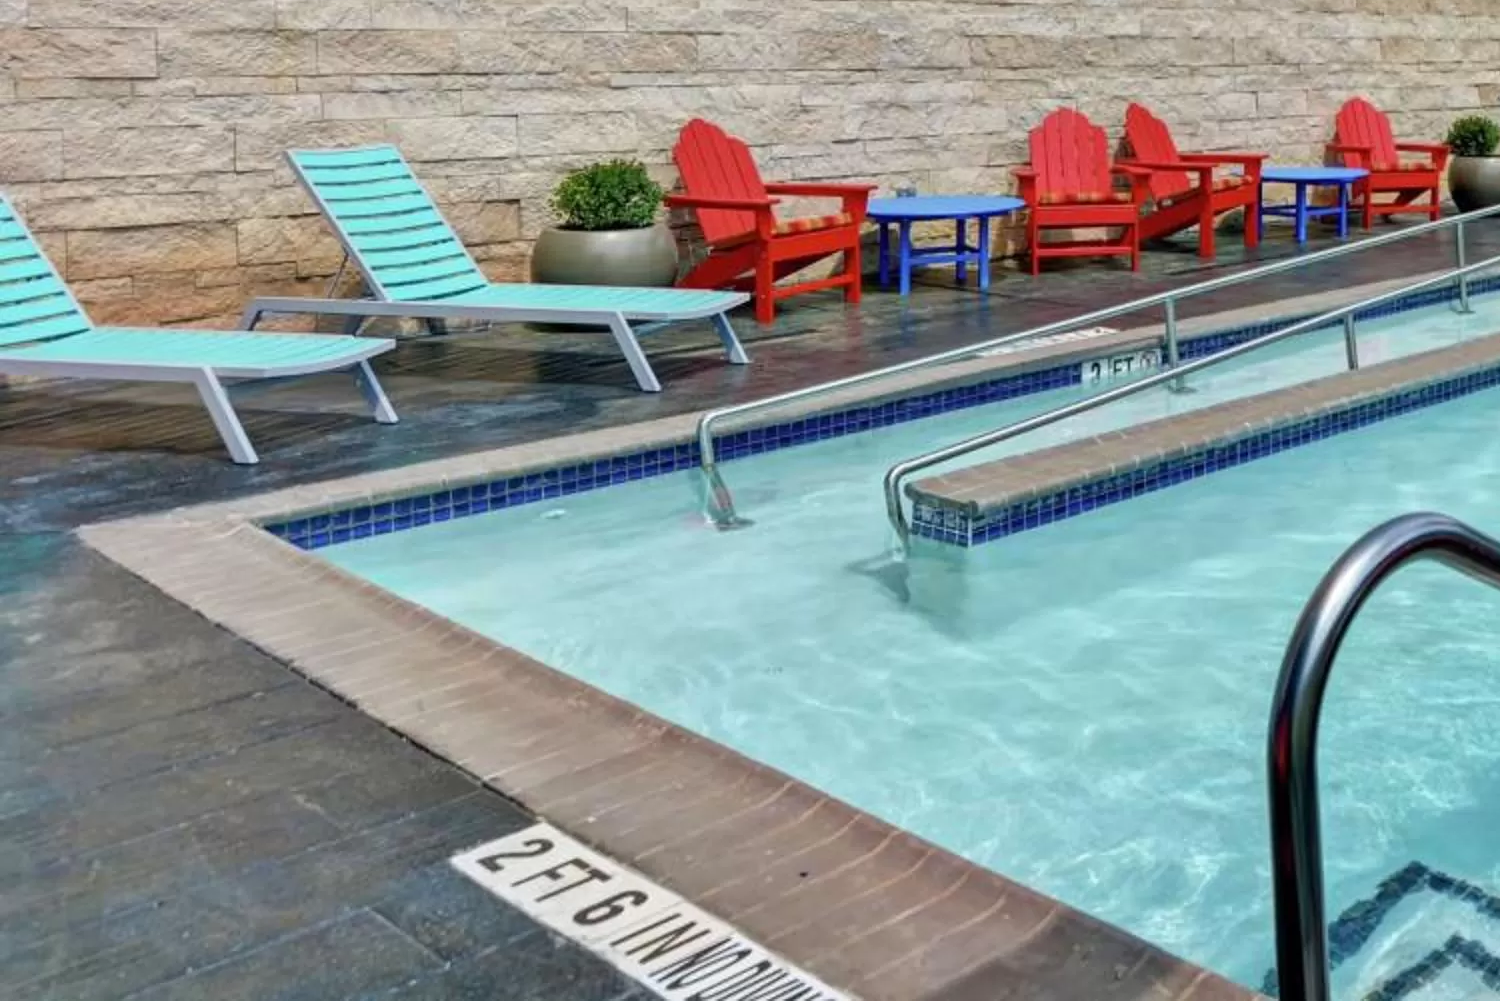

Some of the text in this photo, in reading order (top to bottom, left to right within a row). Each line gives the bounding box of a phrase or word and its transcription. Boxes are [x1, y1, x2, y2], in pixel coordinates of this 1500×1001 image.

[476, 838, 712, 965] 2 FT 6 IN
[648, 937, 837, 1001] NO DIV
